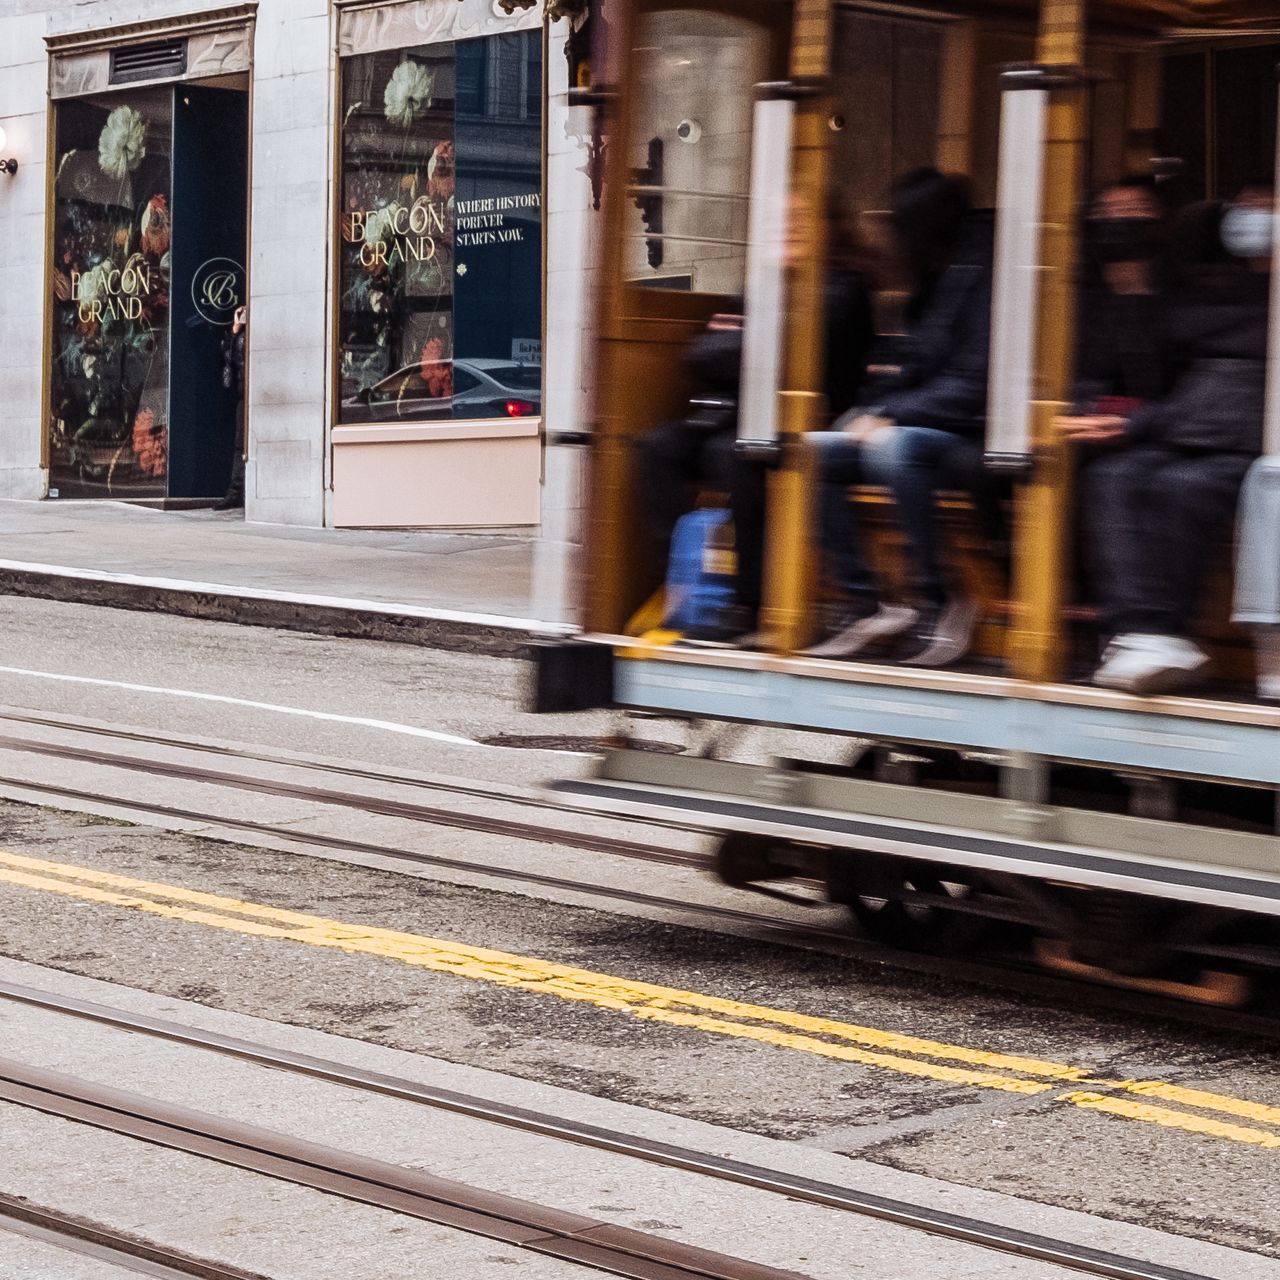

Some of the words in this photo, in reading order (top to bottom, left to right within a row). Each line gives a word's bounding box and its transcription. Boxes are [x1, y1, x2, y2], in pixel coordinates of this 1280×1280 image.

[456, 198, 495, 214] WHERE
[496, 193, 541, 210] HISTORY
[456, 213, 504, 231] FOREVER
[456, 230, 496, 247] STARTS
[497, 228, 524, 244] NOW.
[359, 236, 435, 267] GRAND
[79, 296, 142, 324] GRAND
